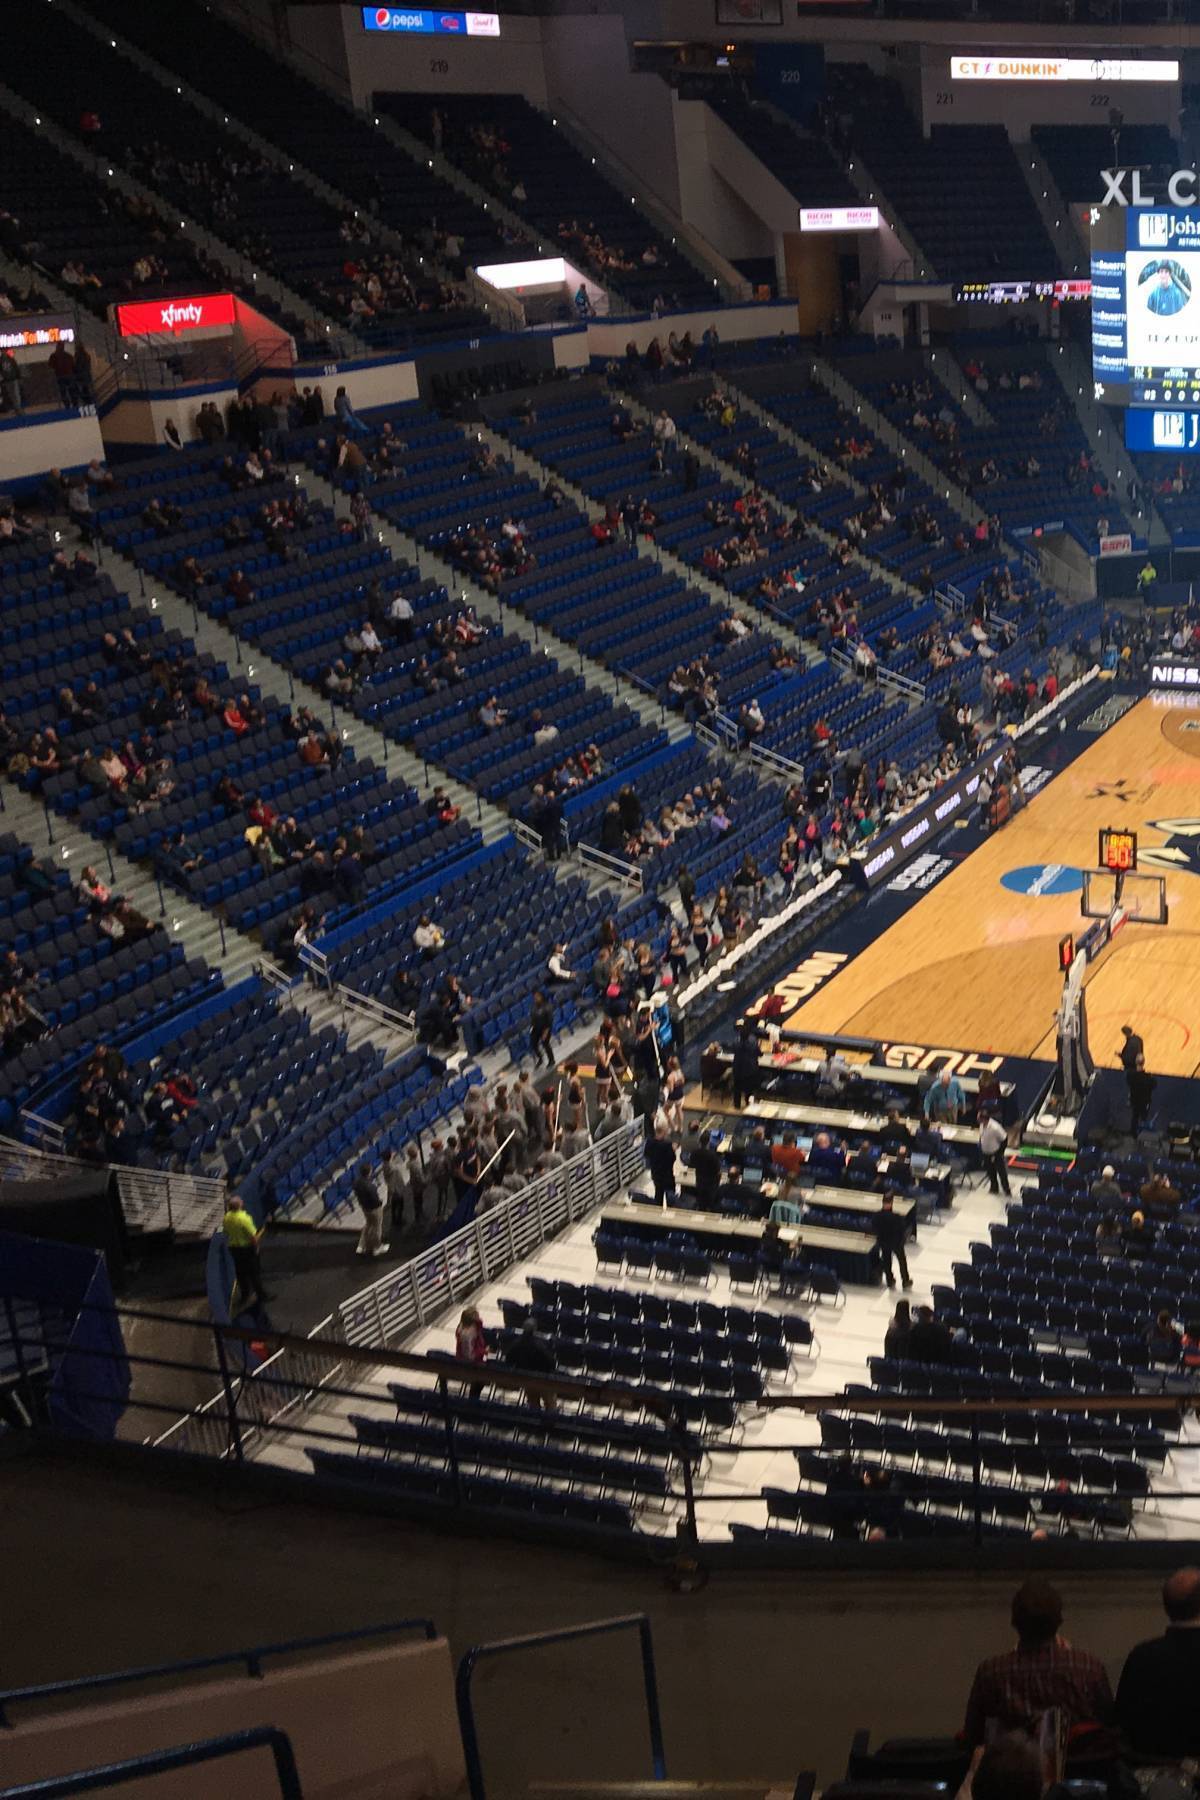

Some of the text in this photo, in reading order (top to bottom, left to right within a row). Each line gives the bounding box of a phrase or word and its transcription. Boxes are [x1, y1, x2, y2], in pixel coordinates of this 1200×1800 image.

[392, 13, 424, 28] pepsi
[998, 63, 1062, 75] DUNKIN'
[1100, 170, 1155, 207] XL
[161, 304, 203, 328] xfinity
